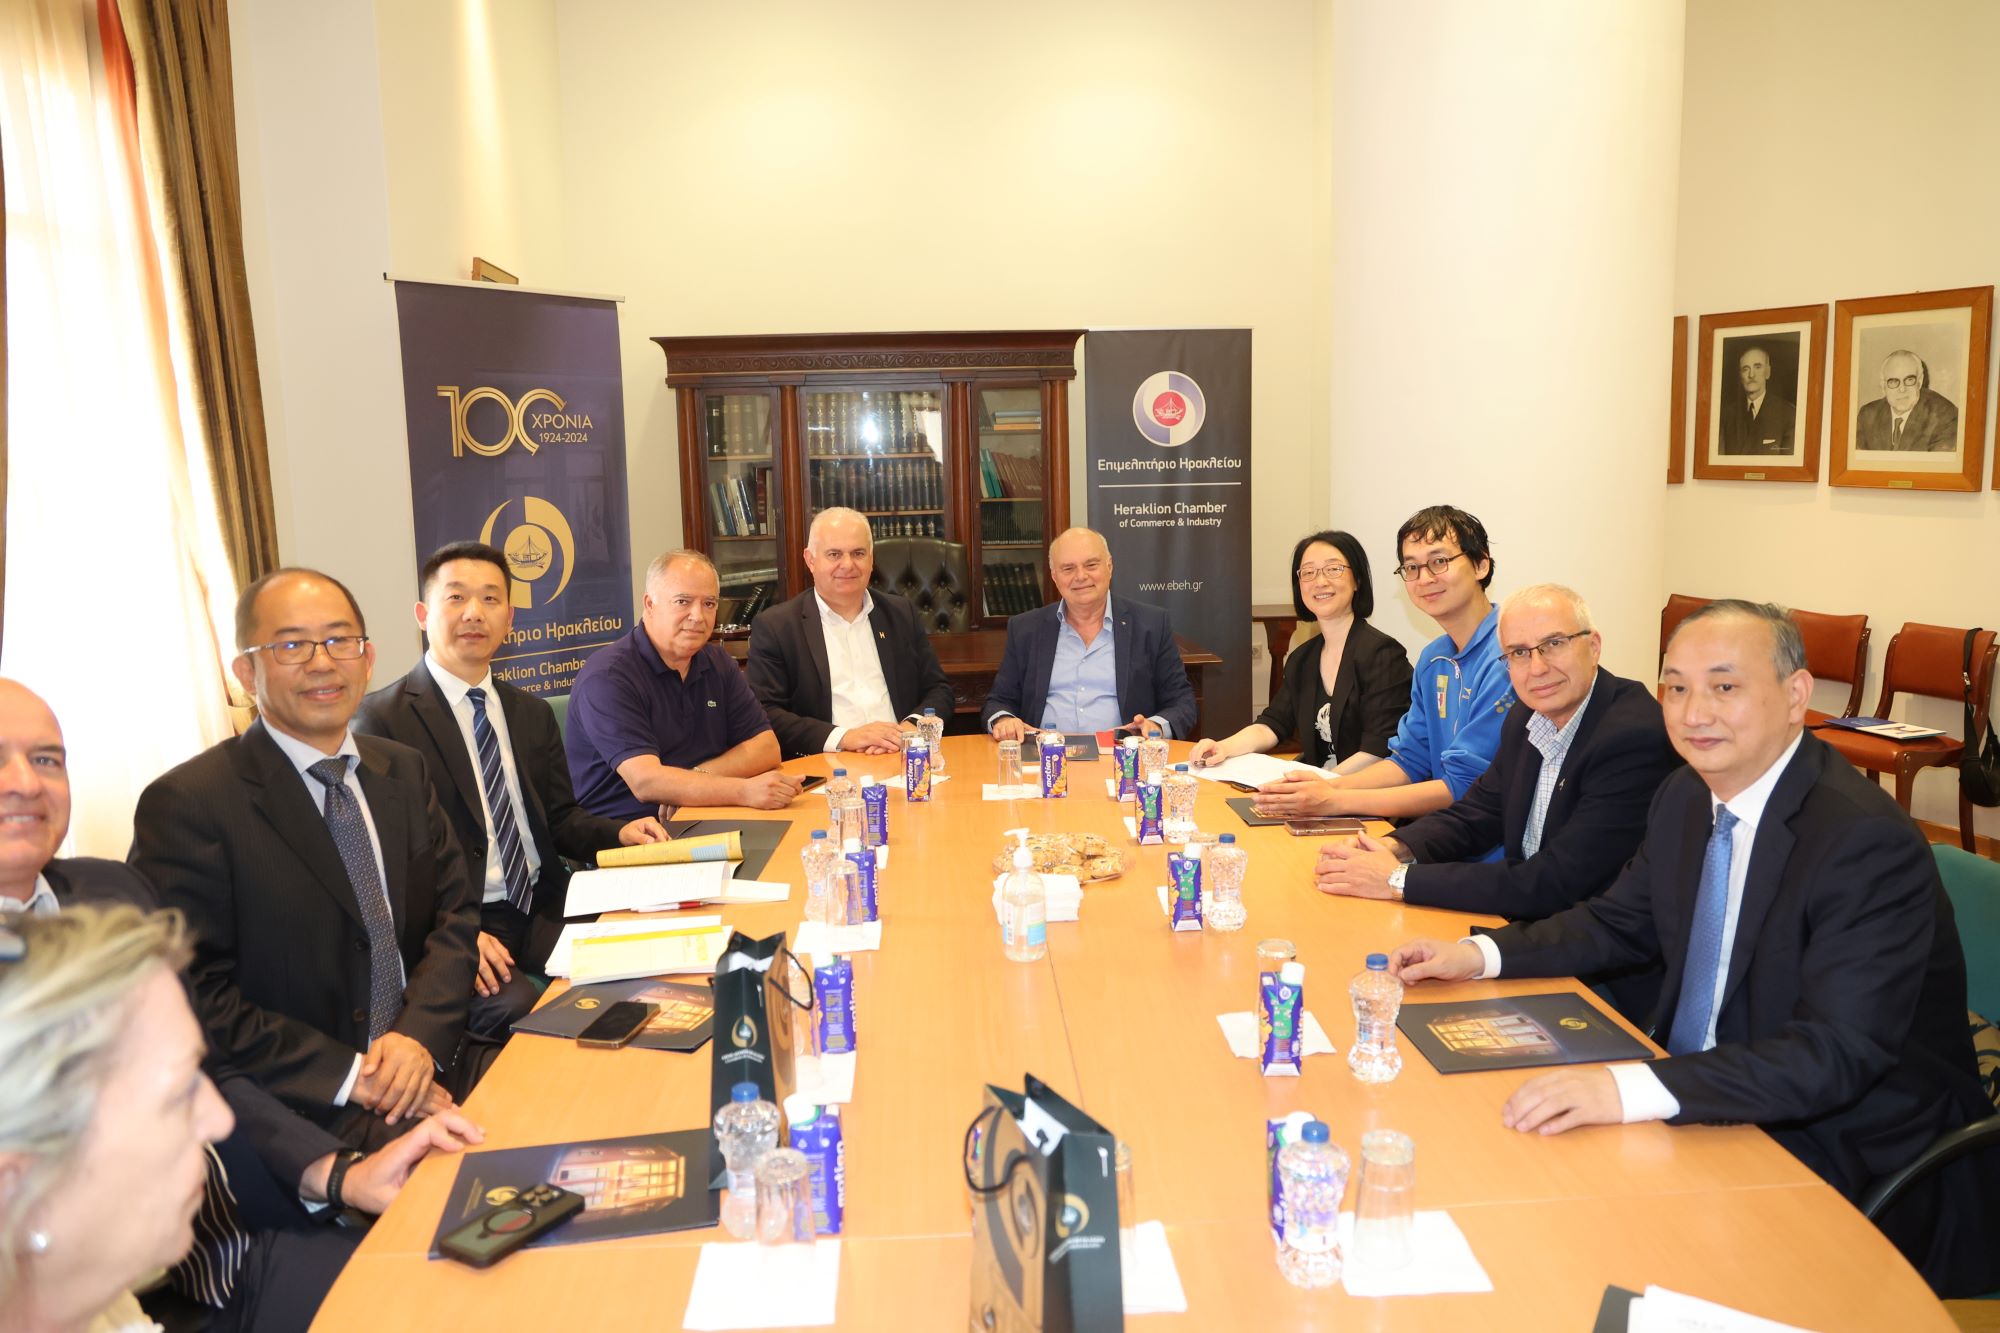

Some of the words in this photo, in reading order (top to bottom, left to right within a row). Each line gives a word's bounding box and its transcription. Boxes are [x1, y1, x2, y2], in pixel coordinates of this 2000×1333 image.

[531, 413, 593, 429] ΧΡΟΝΙΑ
[538, 432, 588, 443] 1924-2024
[1097, 458, 1177, 473] Επιμελητήριο
[1179, 456, 1242, 471] Ηρακλείου
[1113, 503, 1171, 515] Heraklion
[1174, 502, 1227, 514] Chamber
[1119, 518, 1129, 528] of
[1130, 518, 1176, 528] Commerce
[1177, 518, 1185, 527] &
[1186, 517, 1222, 528] Industry
[1139, 580, 1204, 592] www.ebeh.gr
[546, 616, 622, 642] Ηρακλείου
[493, 666, 536, 681] aklion
[539, 658, 586, 675] Chambe
[543, 680, 551, 690] &
